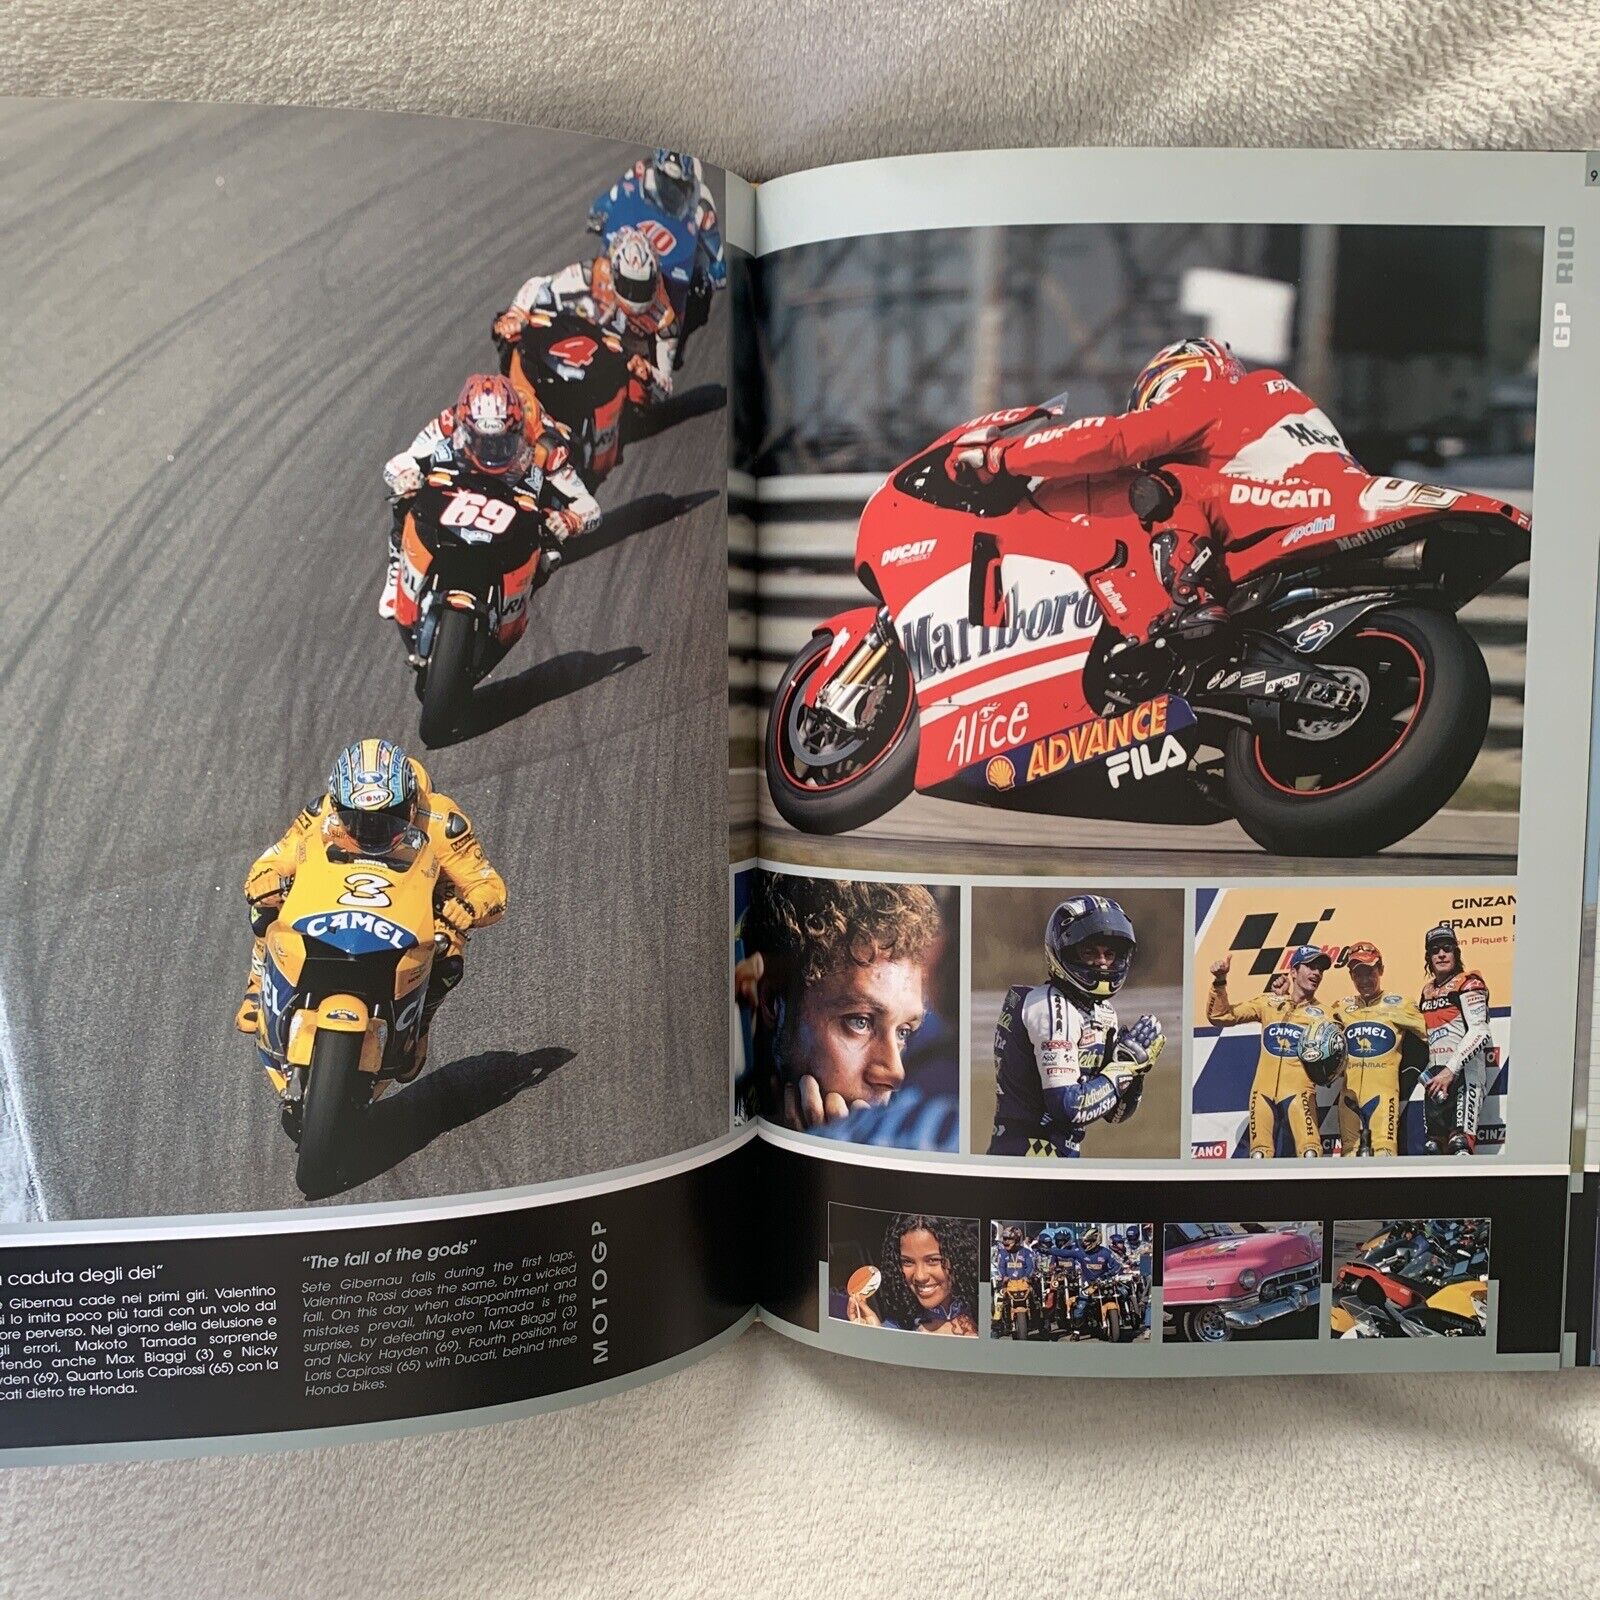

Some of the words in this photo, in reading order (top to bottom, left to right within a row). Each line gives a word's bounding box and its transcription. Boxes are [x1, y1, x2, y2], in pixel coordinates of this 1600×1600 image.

[1555, 226, 1575, 284] RIO
[1552, 302, 1572, 348] GP
[440, 490, 517, 534] 69
[1230, 484, 1332, 509] DUCATI
[880, 539, 938, 568] DUCATI
[1335, 518, 1407, 553] Marlboro
[901, 579, 1099, 684] Marlboro
[946, 701, 1030, 767] Alice
[1025, 693, 1171, 783] ADVANCE
[1105, 734, 1188, 789] FILA
[336, 872, 394, 908] 3
[305, 913, 404, 950] CAMEL
[1438, 915, 1504, 930] GRAND
[1471, 934, 1508, 947] Piquet
[1346, 1026, 1388, 1039] CAMEL
[1386, 1097, 1396, 1141] HONDA
[301, 1281, 331, 1294] Sete
[340, 1276, 403, 1290] Gibernau
[411, 1271, 436, 1283] falls
[444, 1266, 485, 1279] during
[493, 1261, 514, 1272] the
[521, 1255, 542, 1268] first
[344, 1251, 370, 1266] fall
[374, 1248, 392, 1264] of
[396, 1247, 423, 1262] the
[7, 1269, 74, 1286] caduta
[79, 1266, 123, 1285] degli
[303, 1294, 362, 1308] Valentino
[367, 1289, 397, 1302] Rossi
[401, 1287, 432, 1299] does
[437, 1284, 457, 1294] the
[503, 1275, 519, 1286] by
[522, 1273, 531, 1282] a
[536, 1262, 577, 1280] wicked
[591, 1220, 610, 1366] MOTOGP
[9, 1298, 73, 1310] Gibernau
[79, 1294, 116, 1306] cade
[122, 1292, 142, 1304] nei
[148, 1290, 180, 1305] primi
[214, 1285, 276, 1299] Valentino
[10, 1313, 23, 1325] lo
[28, 1312, 61, 1324] imita
[66, 1311, 102, 1324] poco
[107, 1307, 128, 1322] più
[133, 1306, 163, 1319] tardi
[168, 1306, 195, 1317] con
[200, 1305, 217, 1315] un
[221, 1302, 250, 1313] volo
[255, 1299, 276, 1312] dal
[303, 1324, 359, 1338] mistakes
[425, 1310, 475, 1325] Makoto
[484, 1301, 534, 1317] Tamada
[542, 1297, 550, 1307] is
[558, 1293, 577, 1304] the
[331, 1309, 351, 1320] On
[357, 1306, 377, 1318] this
[383, 1304, 409, 1316] day
[414, 1300, 449, 1312] when
[454, 1282, 549, 1307] disappointment
[553, 1276, 577, 1291] and
[75, 1338, 128, 1352] Makoto
[140, 1334, 197, 1348] Tamada
[209, 1330, 278, 1345] sorprende
[91, 1323, 113, 1336] Nel
[117, 1323, 160, 1337] giorno
[164, 1319, 197, 1332] della
[201, 1316, 263, 1330] delusione
[267, 1316, 277, 1326] e
[304, 1354, 331, 1367] and
[337, 1351, 373, 1364] Nicky
[379, 1346, 428, 1360] Hayden
[468, 1333, 506, 1348] Fourth
[511, 1325, 557, 1344] position
[563, 1320, 578, 1331] for
[360, 1336, 377, 1348] by
[383, 1329, 445, 1345] defeating
[451, 1324, 483, 1336] even
[489, 1319, 515, 1331] Max
[520, 1309, 557, 1326] Biaggi
[562, 1305, 577, 1319] (3)
[0, 1358, 42, 1370] tendo
[51, 1355, 97, 1368] anche
[106, 1353, 135, 1365] Max
[144, 1349, 186, 1364] Biaggi
[195, 1348, 214, 1362] (3)
[223, 1349, 232, 1358] e
[241, 1344, 278, 1357] Nicky
[66, 1369, 113, 1382] Quarto
[116, 1367, 145, 1379] Loris
[147, 1363, 205, 1379] Capirossi
[208, 1362, 234, 1376] (65)
[237, 1362, 263, 1372] con
[266, 1359, 279, 1370] la
[305, 1369, 332, 1382] Loris
[336, 1362, 393, 1379] Capirossi
[397, 1359, 421, 1374] (65)
[425, 1356, 450, 1369] with
[502, 1340, 545, 1357] behind
[548, 1335, 578, 1349] three
[25, 1387, 65, 1399] dietro
[68, 1386, 86, 1397] tre
[305, 1383, 349, 1396] Honda
